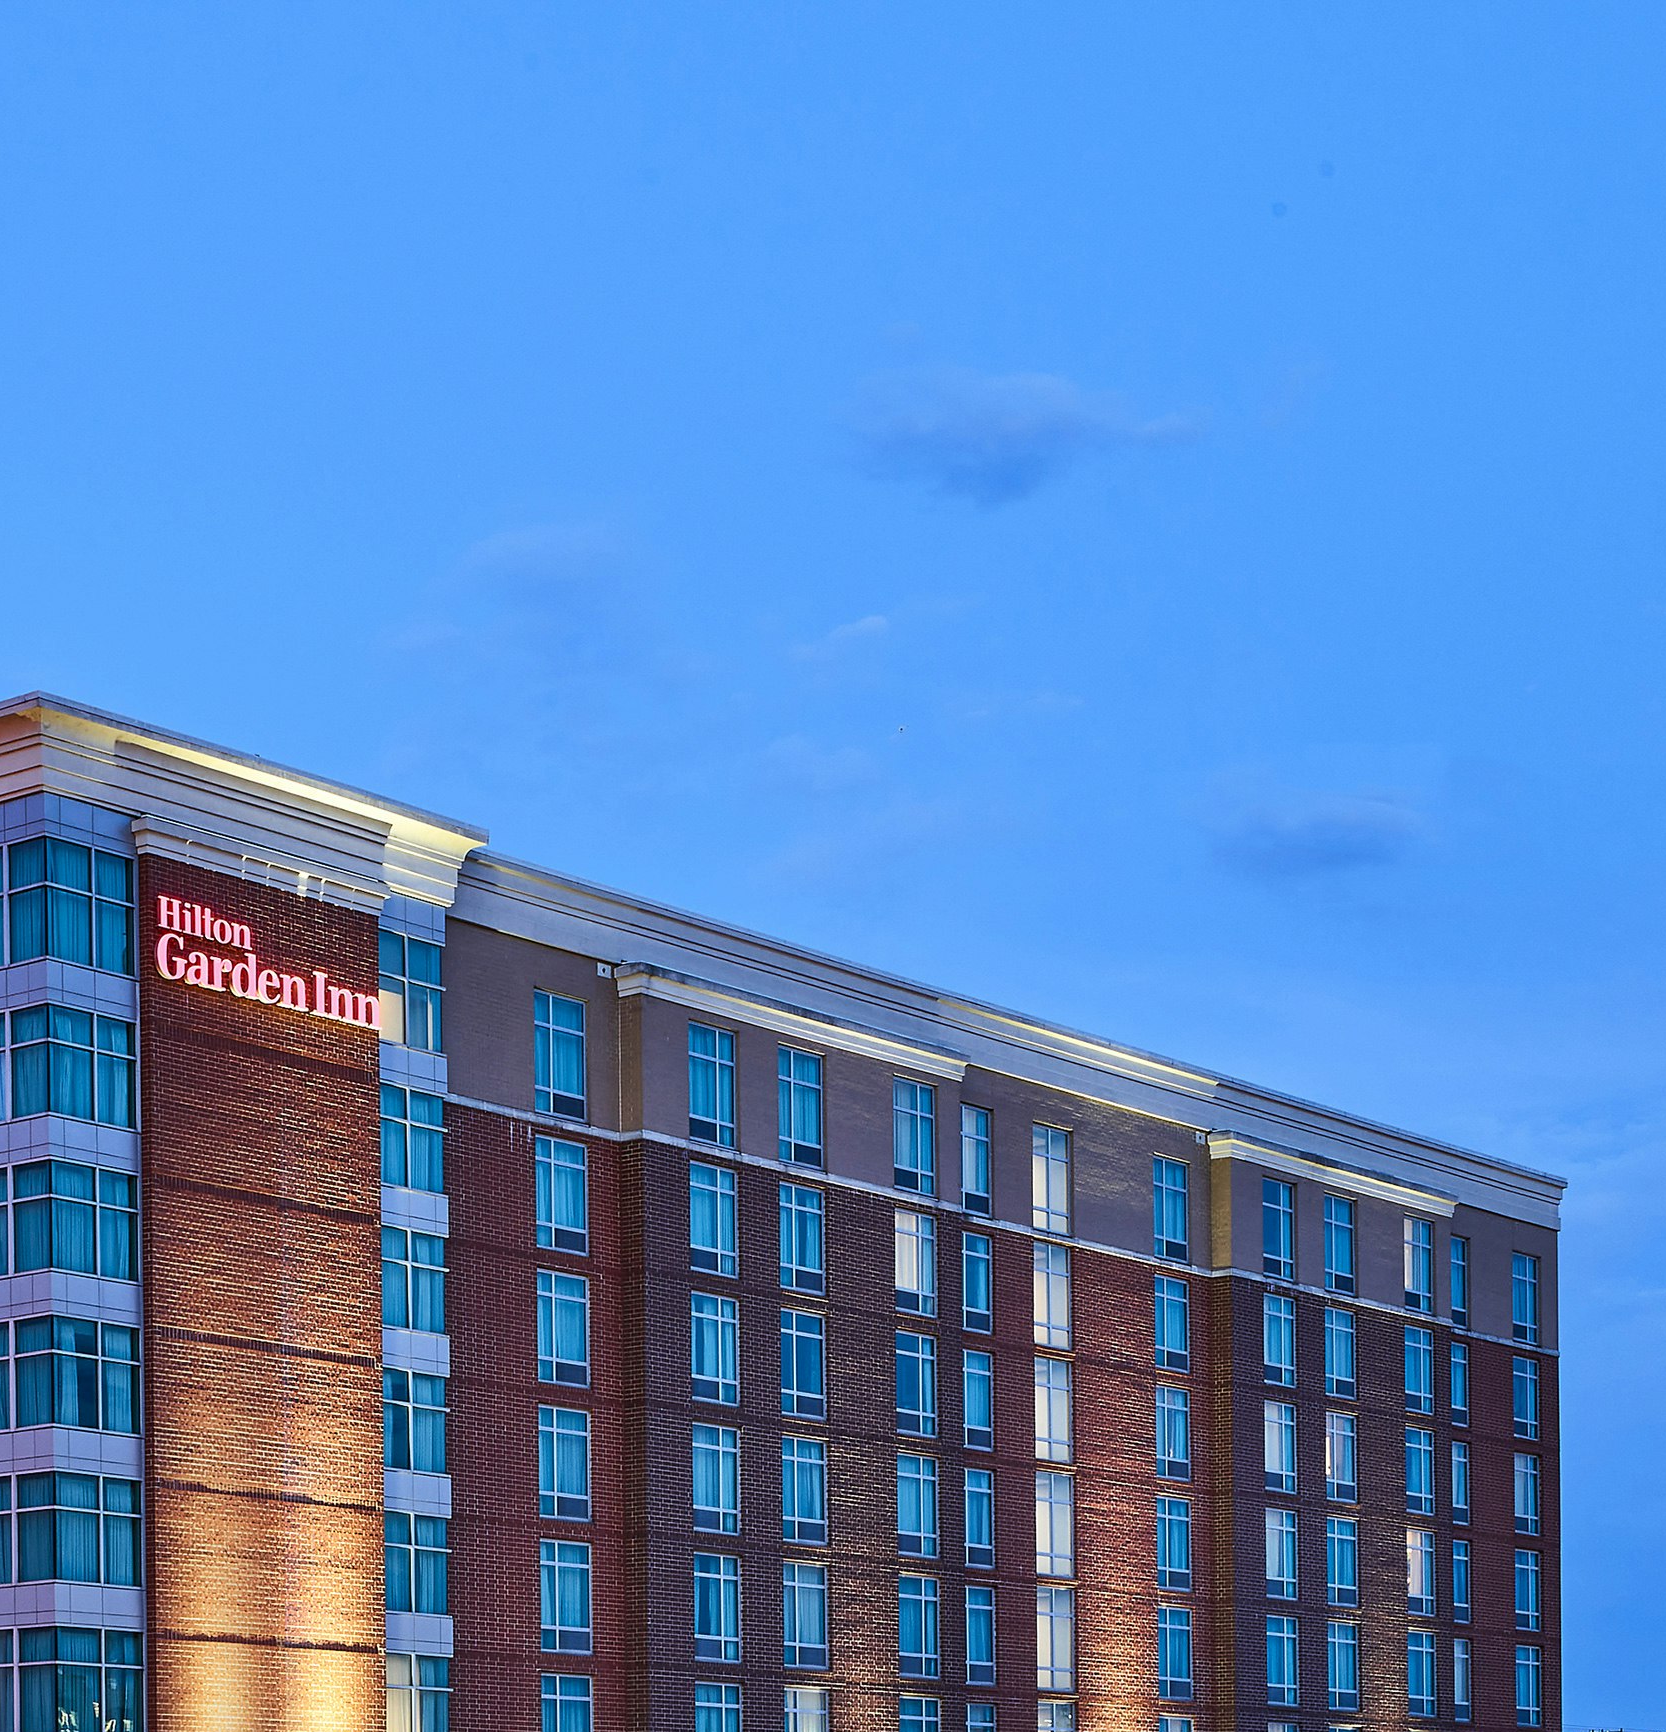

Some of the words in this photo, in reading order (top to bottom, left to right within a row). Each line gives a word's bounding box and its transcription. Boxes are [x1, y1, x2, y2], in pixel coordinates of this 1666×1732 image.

[157, 895, 253, 951] Hilton
[156, 933, 309, 1012] Garden
[310, 971, 381, 1030] Inn
